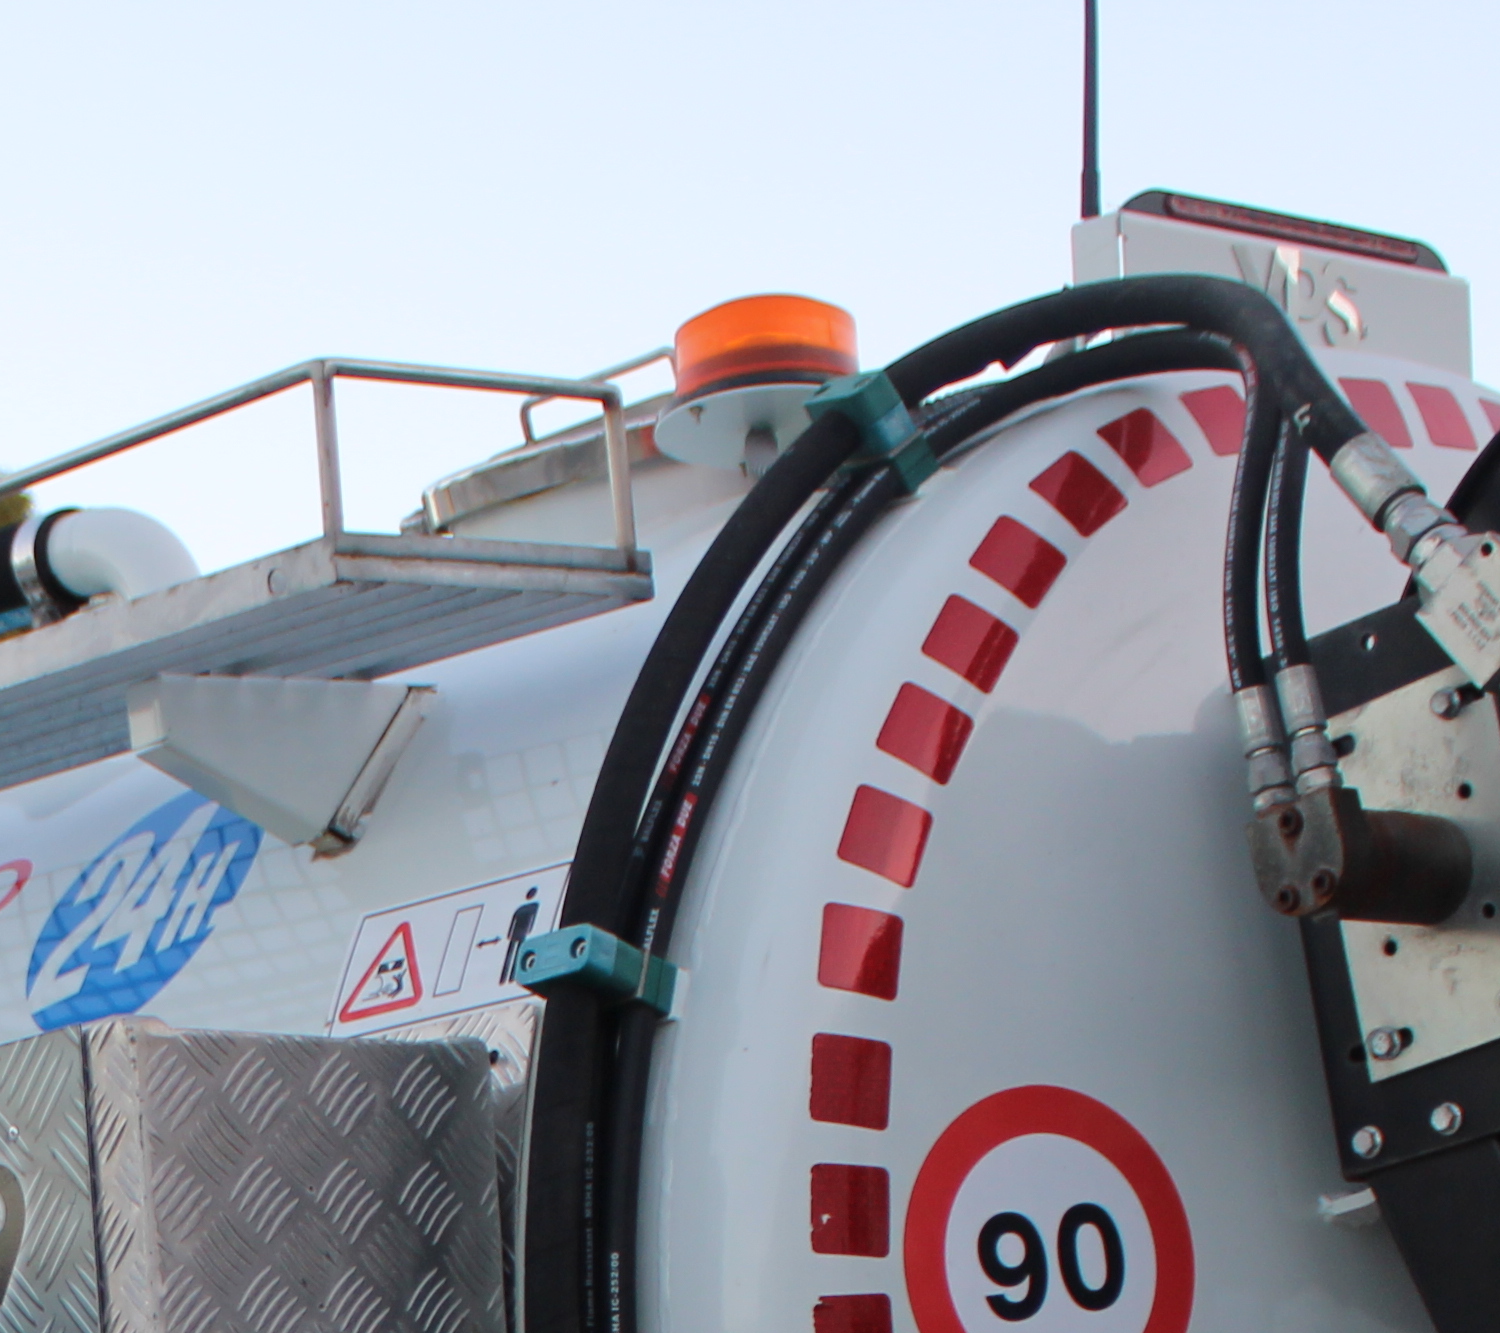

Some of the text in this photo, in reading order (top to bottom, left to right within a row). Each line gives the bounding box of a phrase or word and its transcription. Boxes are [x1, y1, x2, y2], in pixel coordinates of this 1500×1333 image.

[26, 802, 240, 1003] 24H
[643, 907, 659, 949] ALFLEX
[658, 833, 683, 878] FORZA
[675, 799, 693, 828] DUE
[610, 1251, 620, 1310] IC-252/00
[976, 1201, 1127, 1323] 90
